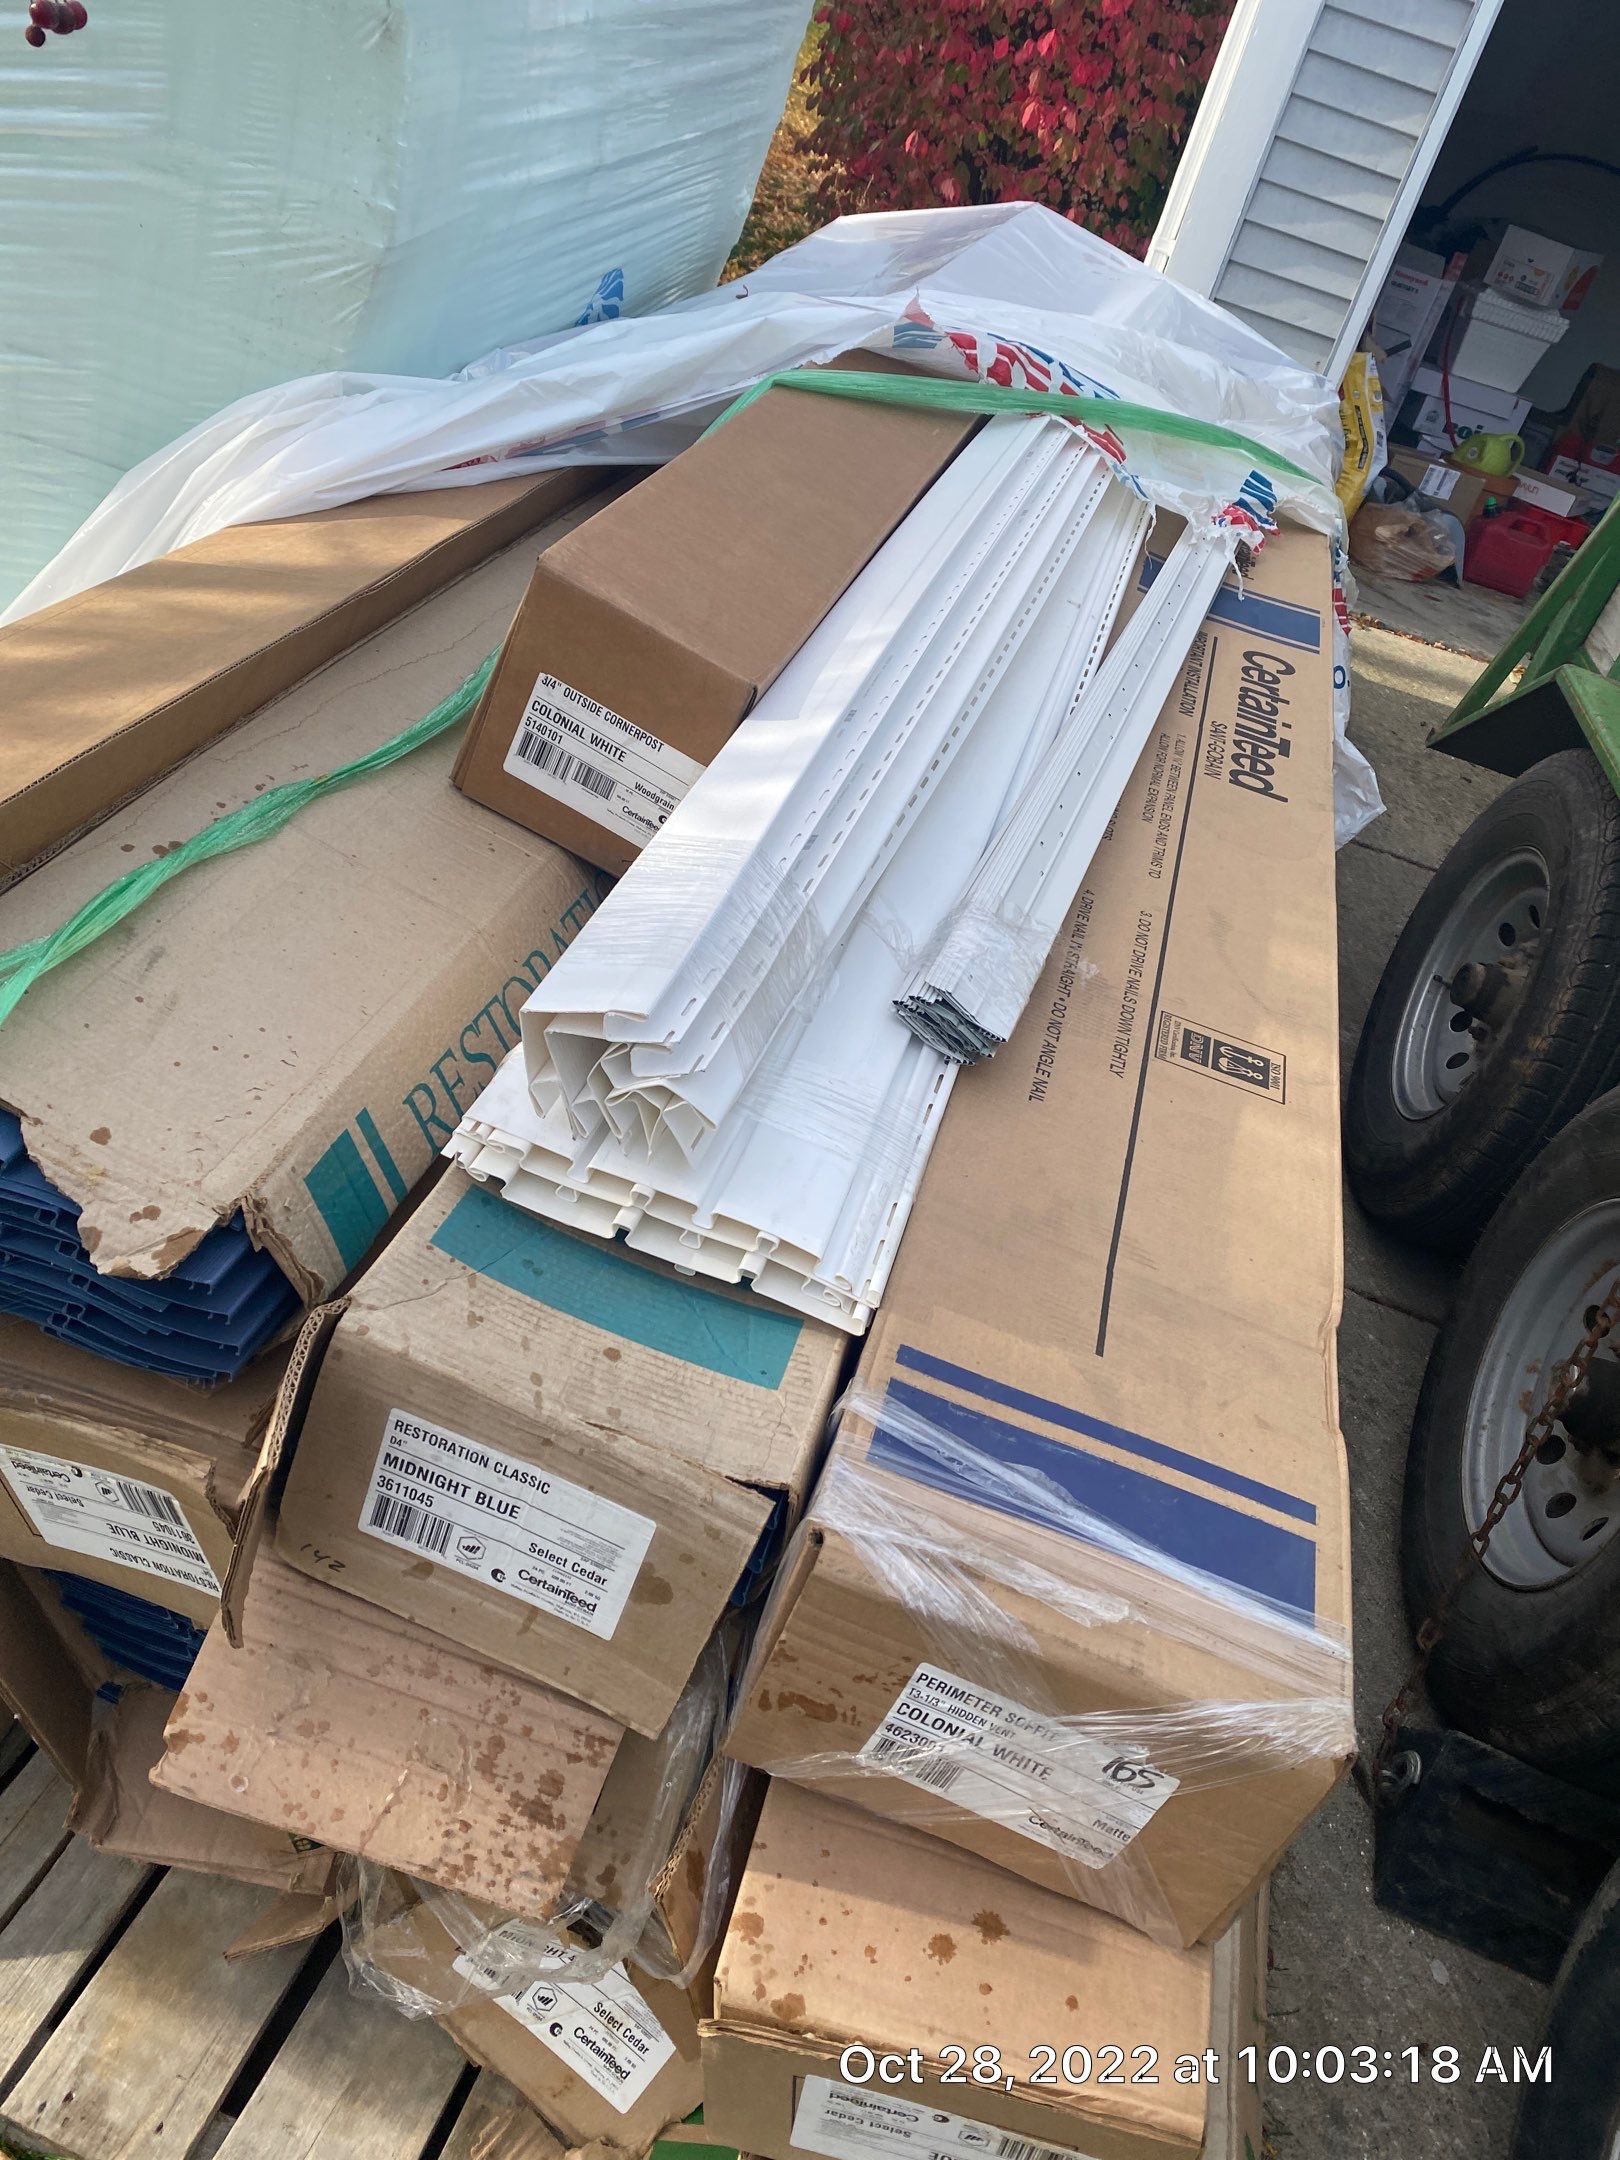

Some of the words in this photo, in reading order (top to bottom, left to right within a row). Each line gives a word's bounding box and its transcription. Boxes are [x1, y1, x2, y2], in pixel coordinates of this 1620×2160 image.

[1179, 665, 1202, 718] INSTALLATION
[525, 716, 564, 745] 5140101
[541, 675, 562, 691] 3/4"
[563, 687, 604, 717] OUTSIDE
[604, 710, 665, 753] CORNERPOST
[1228, 650, 1296, 803] CertainTeed
[531, 700, 586, 740] COLONIAL
[589, 733, 627, 763] WHITE
[634, 781, 675, 811] Woodgrain
[1142, 787, 1159, 824] EXPANSION
[622, 805, 660, 831] CertainTee
[1077, 896, 1094, 922] DRIVE
[1137, 918, 1151, 933] DO
[1072, 920, 1087, 940] NAIL
[1134, 931, 1149, 951] NOT
[1057, 950, 1080, 998] STRAIGHT
[1129, 949, 1146, 978] DRIVE
[1123, 976, 1141, 1005] NAILS
[402, 875, 606, 1160] RESTORATI
[1051, 1001, 1067, 1019] DO
[1117, 1004, 1136, 1037] DOWN
[1045, 1017, 1063, 1042] NOT
[1035, 1039, 1058, 1078] ANGLE
[1109, 1036, 1130, 1079] TIGHTLY
[1028, 1077, 1048, 1102] NAIL
[393, 1419, 490, 1469] RESTORATION
[493, 1461, 551, 1495] CLASSIC
[377, 1474, 435, 1508] 3611045
[382, 1452, 471, 1499] MIDNIGHT
[474, 1490, 521, 1520] BLUE
[105, 1522, 140, 1542] BLUE
[109, 1547, 151, 1568] CLASSIC
[144, 1534, 206, 1565] MIDNIGHT
[528, 1542, 569, 1569] Select
[571, 1562, 608, 1587] Cedar
[152, 1561, 220, 1592] RESTORATION
[517, 1568, 598, 1614] CertainTeed
[915, 1672, 1004, 1717] PERIMETER
[947, 1704, 988, 1727] HIDDEN
[896, 1702, 988, 1751] COLONIAL
[991, 1744, 1056, 1781] WHITE
[1092, 1818, 1131, 1843] Matte
[592, 2001, 623, 2033] Select
[622, 2027, 651, 2055] Cedar
[573, 2026, 631, 2081] CertainTeed
